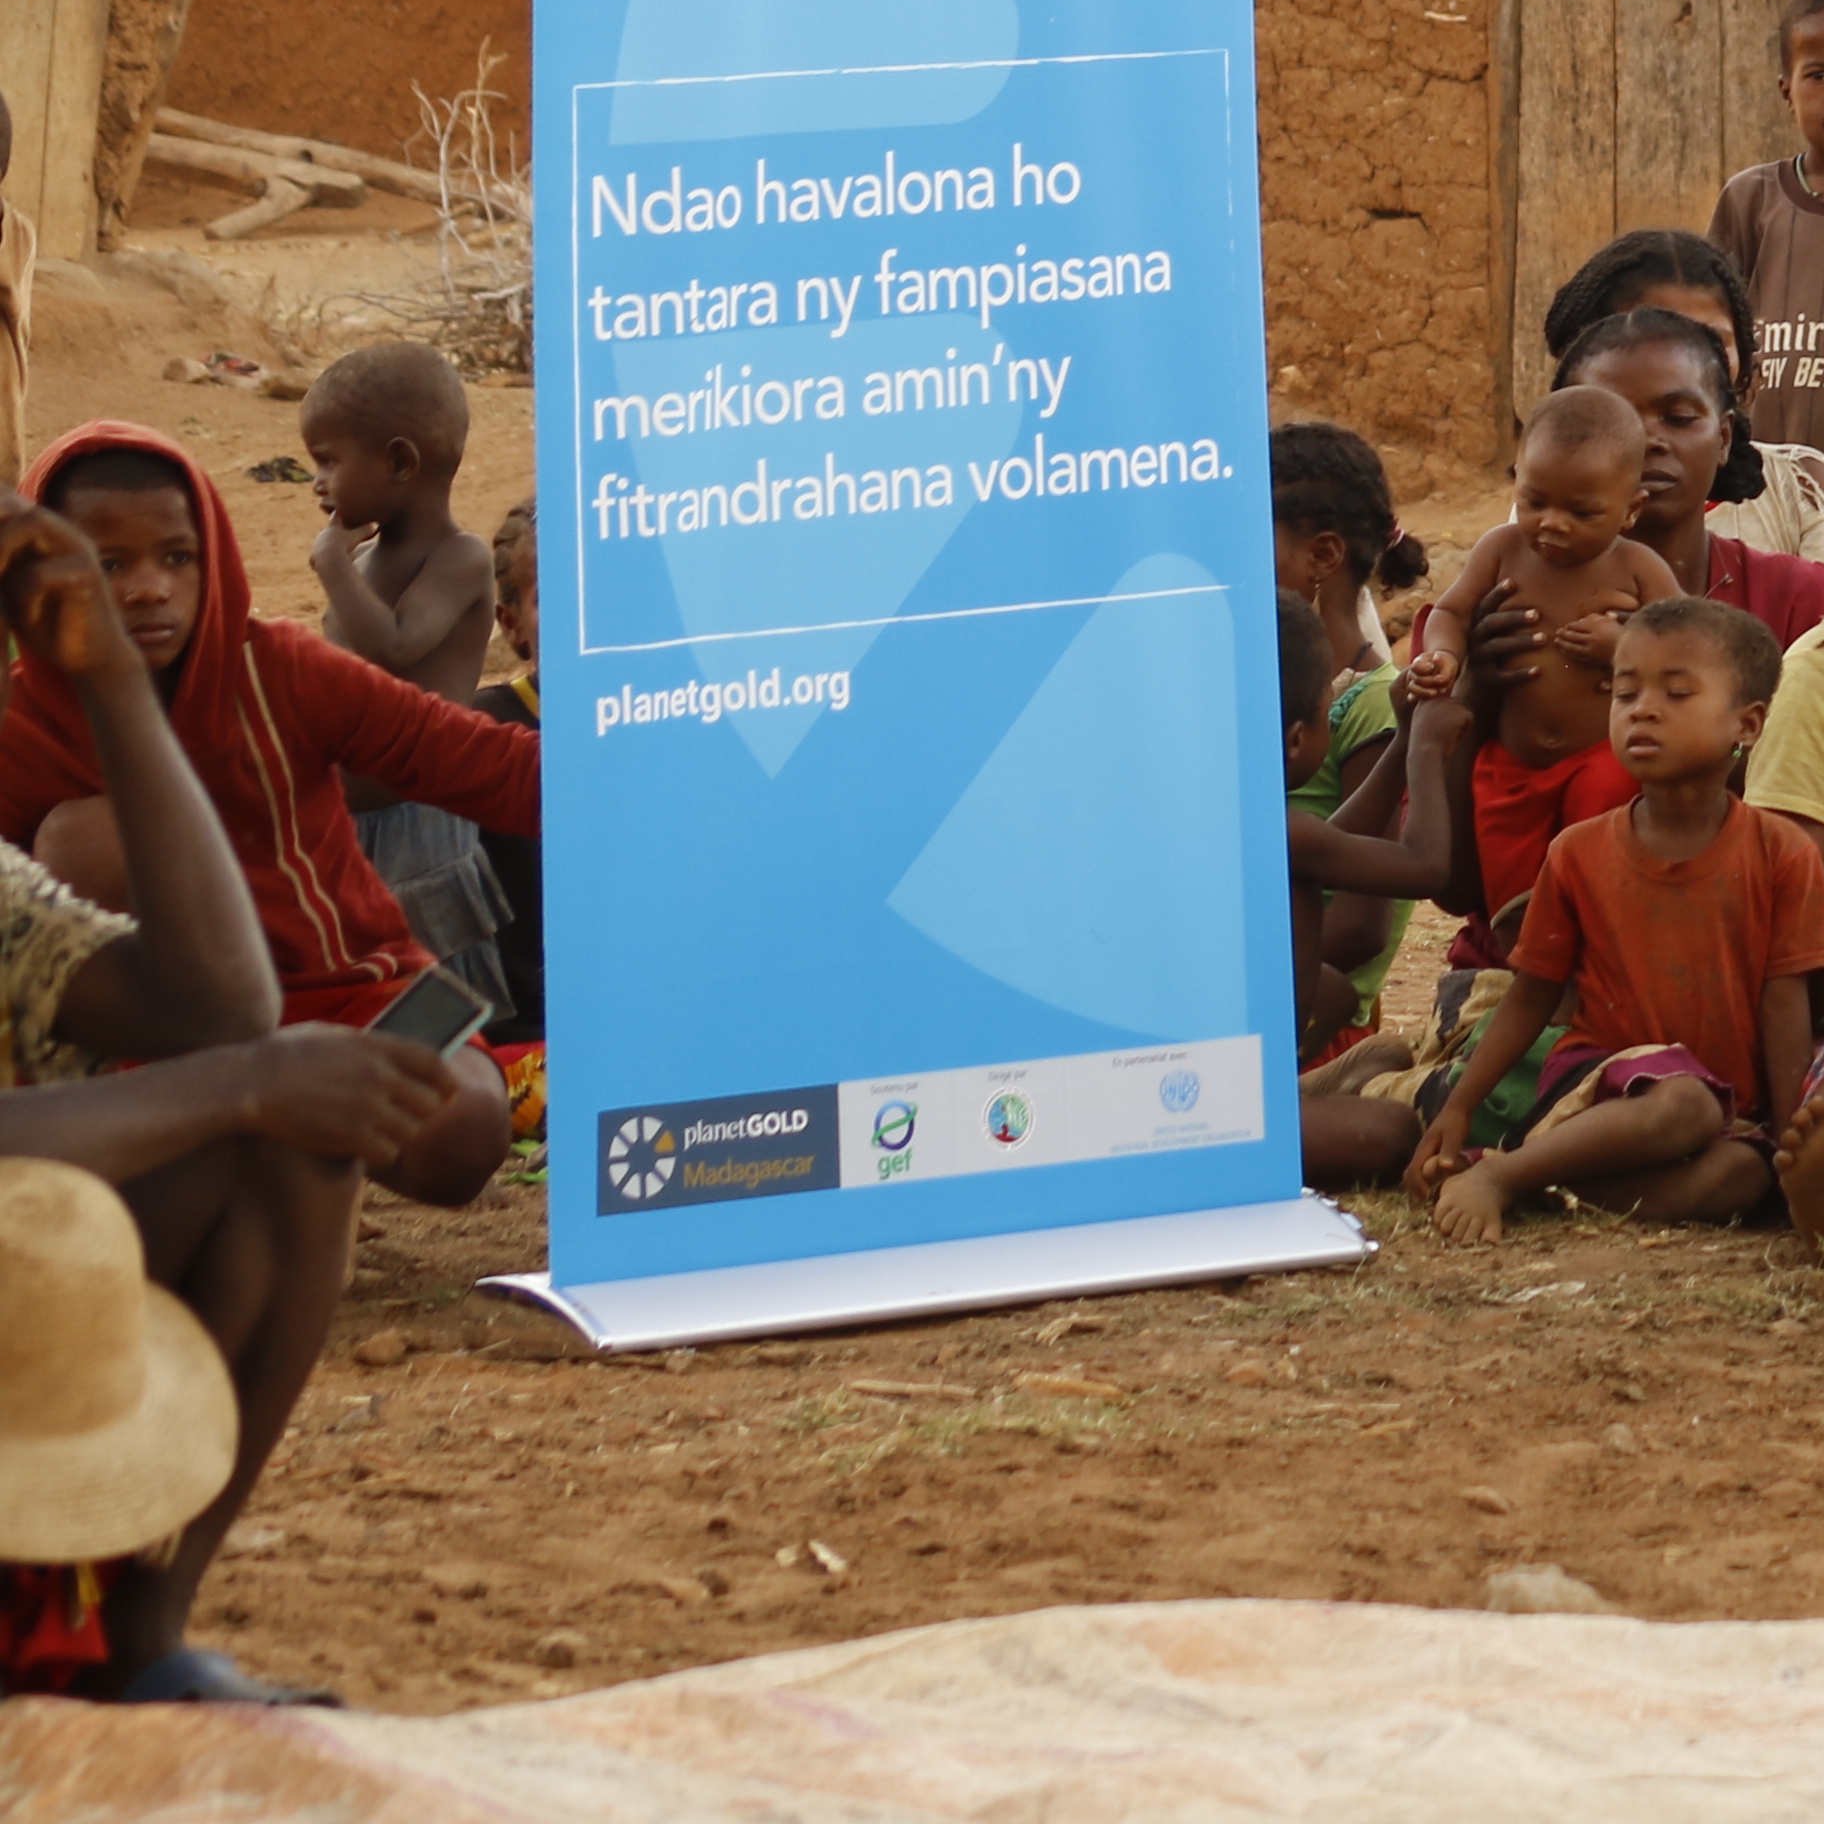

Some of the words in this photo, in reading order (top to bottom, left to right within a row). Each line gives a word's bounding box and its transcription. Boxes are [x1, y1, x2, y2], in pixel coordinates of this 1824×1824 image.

[592, 166, 742, 237] Ndao
[757, 151, 995, 224] havalona
[1013, 143, 1082, 206] ho
[588, 279, 777, 341] tantara
[797, 275, 862, 338] ny
[874, 244, 1172, 329] fampiasana
[593, 364, 845, 441] merikiora
[862, 343, 1071, 418] amin'ny
[592, 452, 953, 539] fitrandrahana
[968, 433, 1234, 501] volamena.
[597, 667, 850, 736] planetgold.org
[683, 1108, 810, 1153] planetGOLD
[683, 1153, 816, 1189] Madagascar
[878, 1147, 913, 1180] gef
